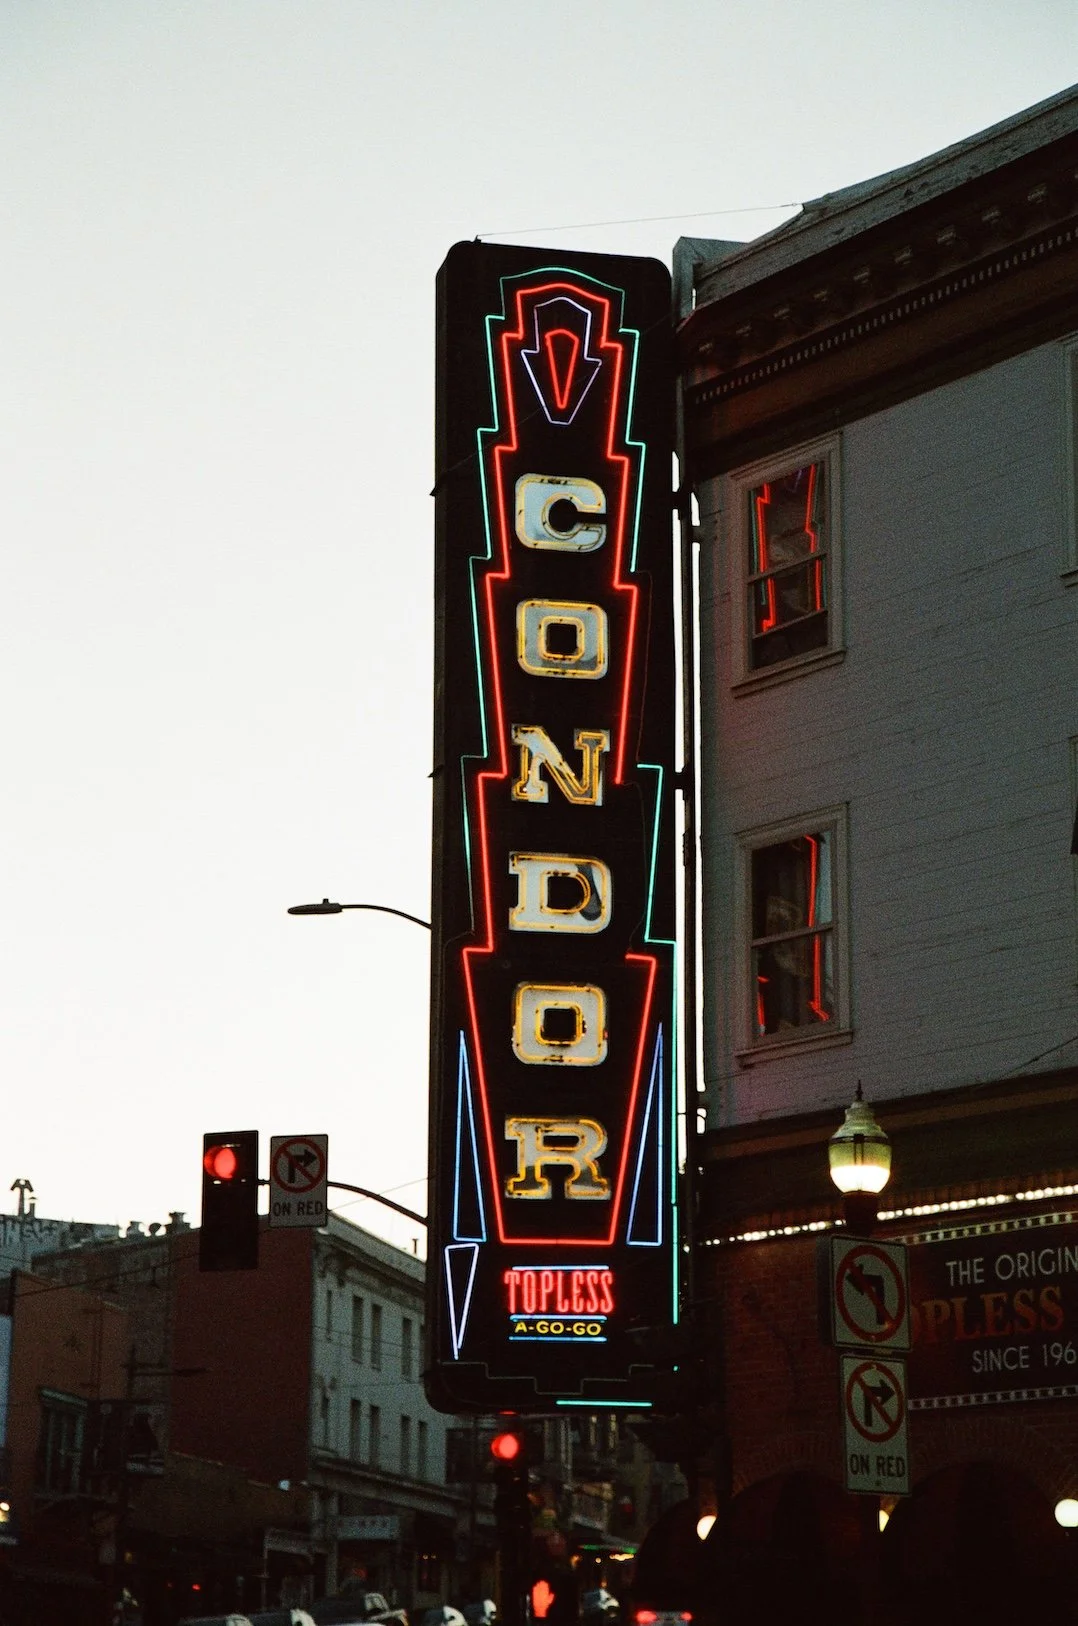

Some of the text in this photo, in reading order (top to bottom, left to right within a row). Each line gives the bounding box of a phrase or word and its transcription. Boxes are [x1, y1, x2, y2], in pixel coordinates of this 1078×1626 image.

[505, 473, 612, 1200] CONDOR
[273, 1200, 323, 1217] ON RED
[945, 1257, 985, 1286] THE
[503, 1270, 614, 1314] TOPLESS
[515, 1320, 602, 1336] A-GO-GO
[972, 1345, 1030, 1373] SINCE
[850, 1453, 906, 1478] ON RED
